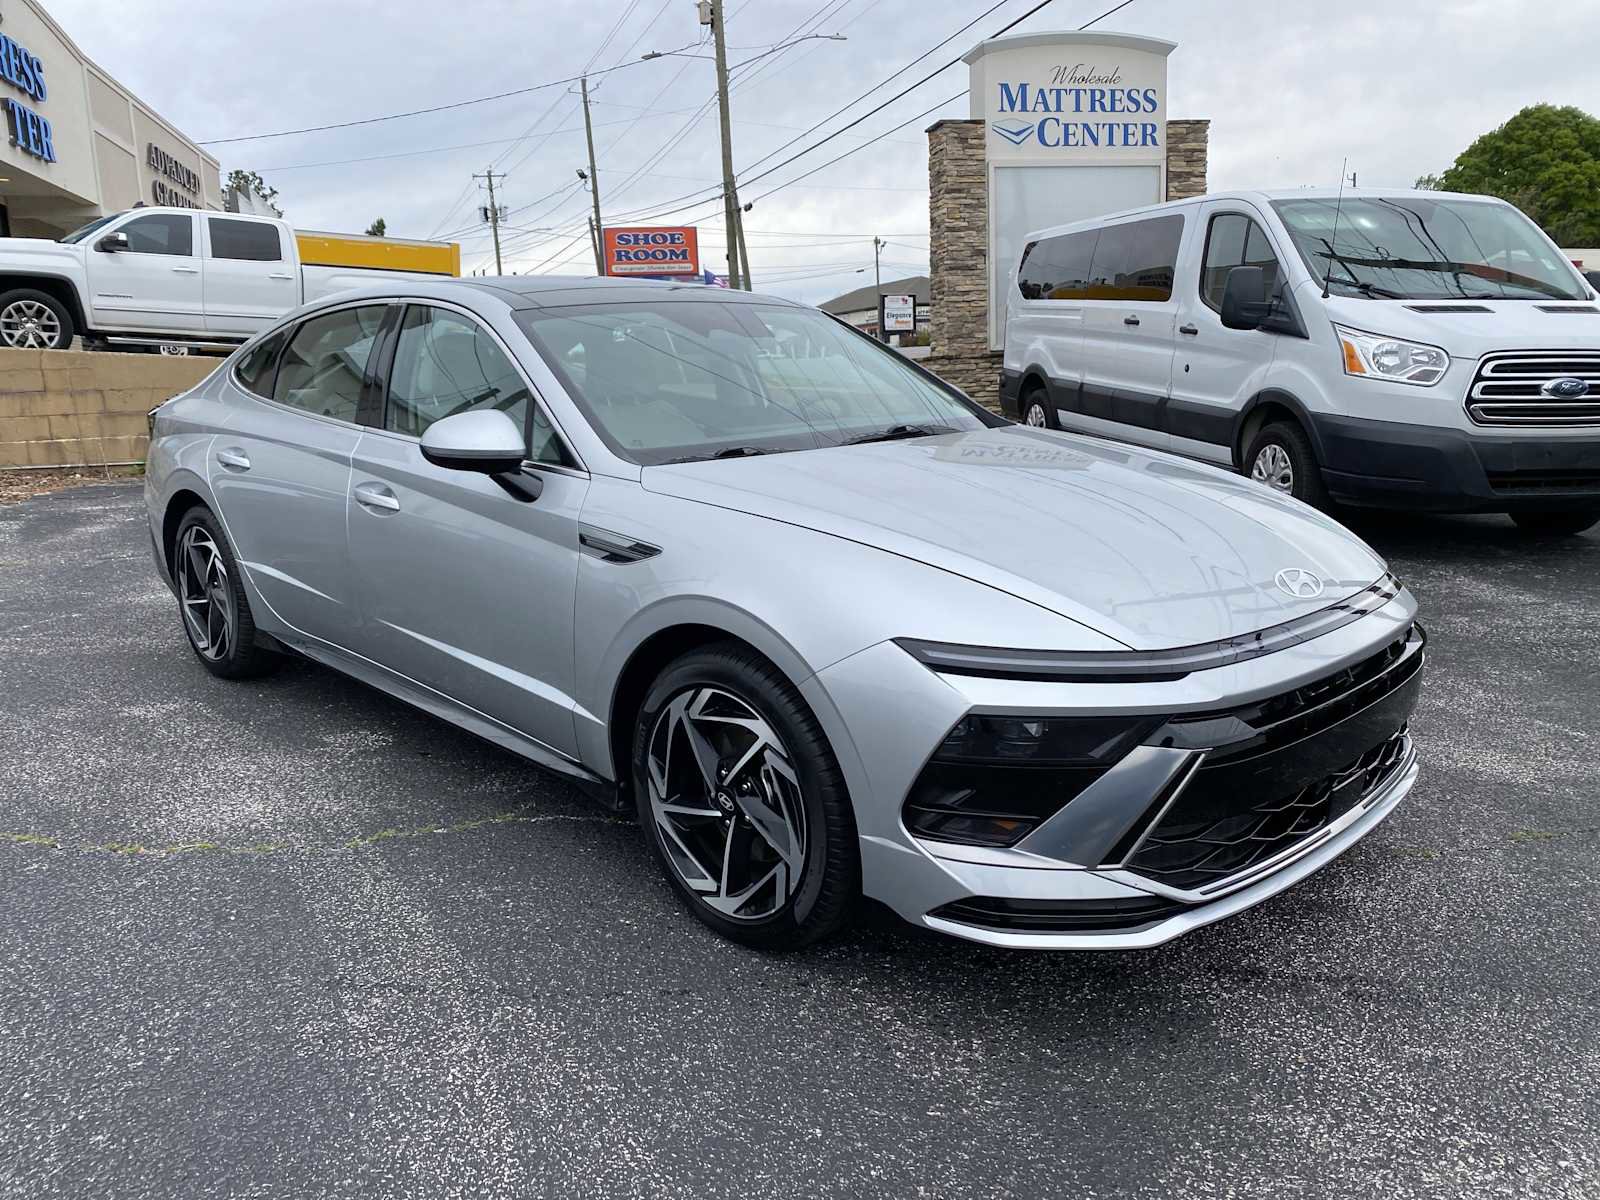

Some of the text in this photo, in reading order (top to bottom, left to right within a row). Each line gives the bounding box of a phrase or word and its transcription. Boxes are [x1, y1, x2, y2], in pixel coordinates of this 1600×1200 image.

[1050, 63, 1122, 85] Wholesale
[998, 82, 1157, 113] MATTRESS
[1037, 117, 1160, 147] CENTER
[147, 143, 201, 194] ADVANCED
[616, 232, 684, 245] SHOE
[615, 248, 689, 261] ROOM
